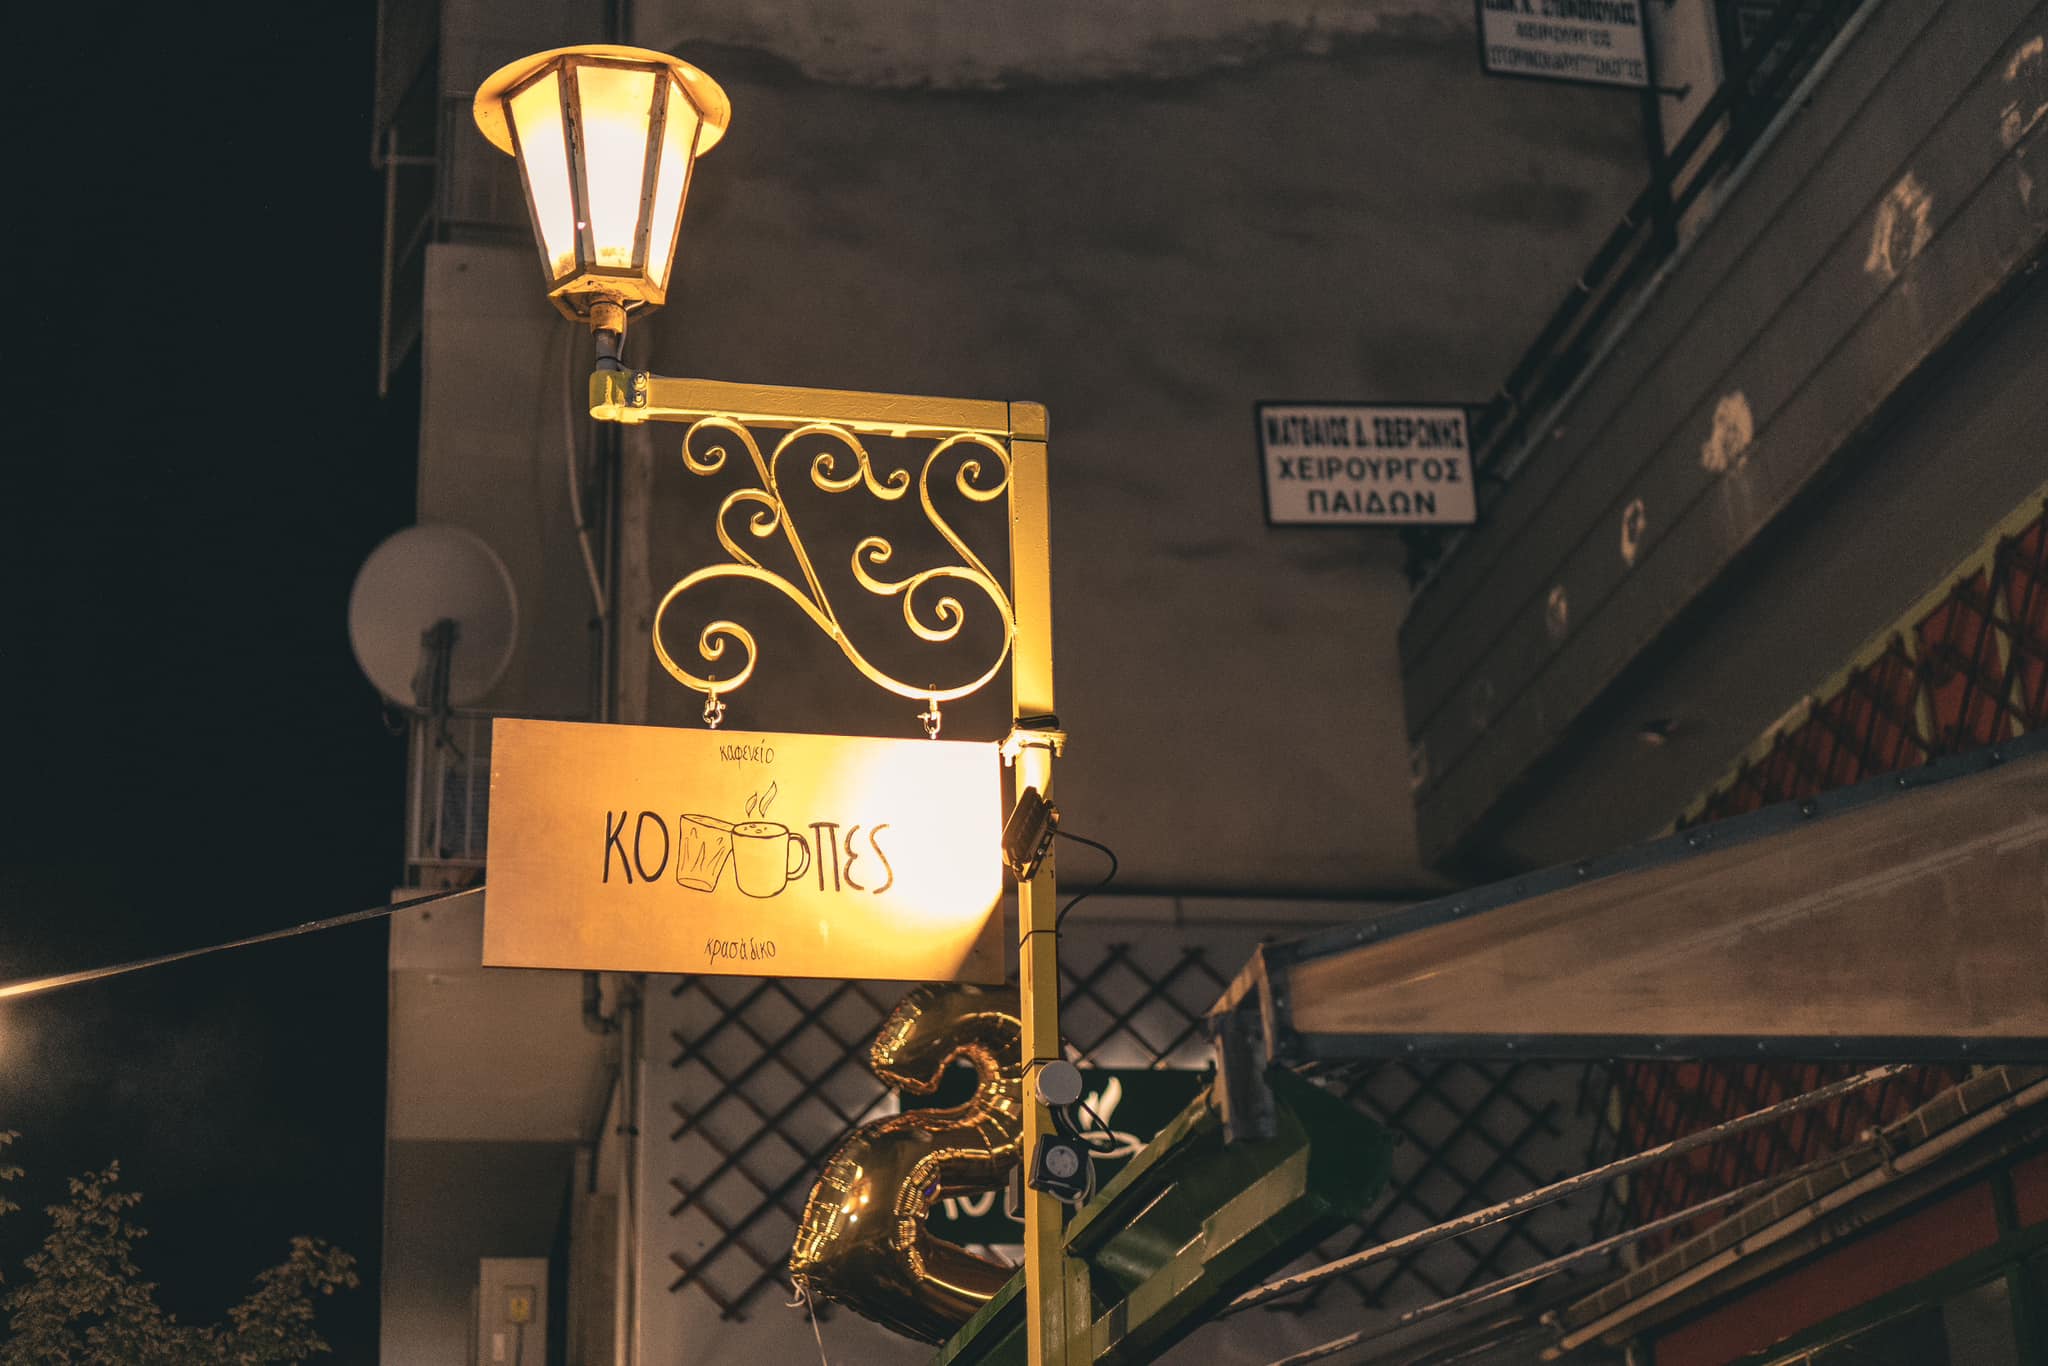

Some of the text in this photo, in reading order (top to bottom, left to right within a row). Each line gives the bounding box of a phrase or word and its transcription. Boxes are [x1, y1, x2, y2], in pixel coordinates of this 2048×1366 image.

[1278, 455, 1461, 482] ΧΕΙΡΟΥΡΓΟΣ
[1308, 489, 1436, 515] ΠΑΙΔΩΝ
[719, 738, 775, 771] καφενείο
[703, 937, 776, 966] κρασάδικο
